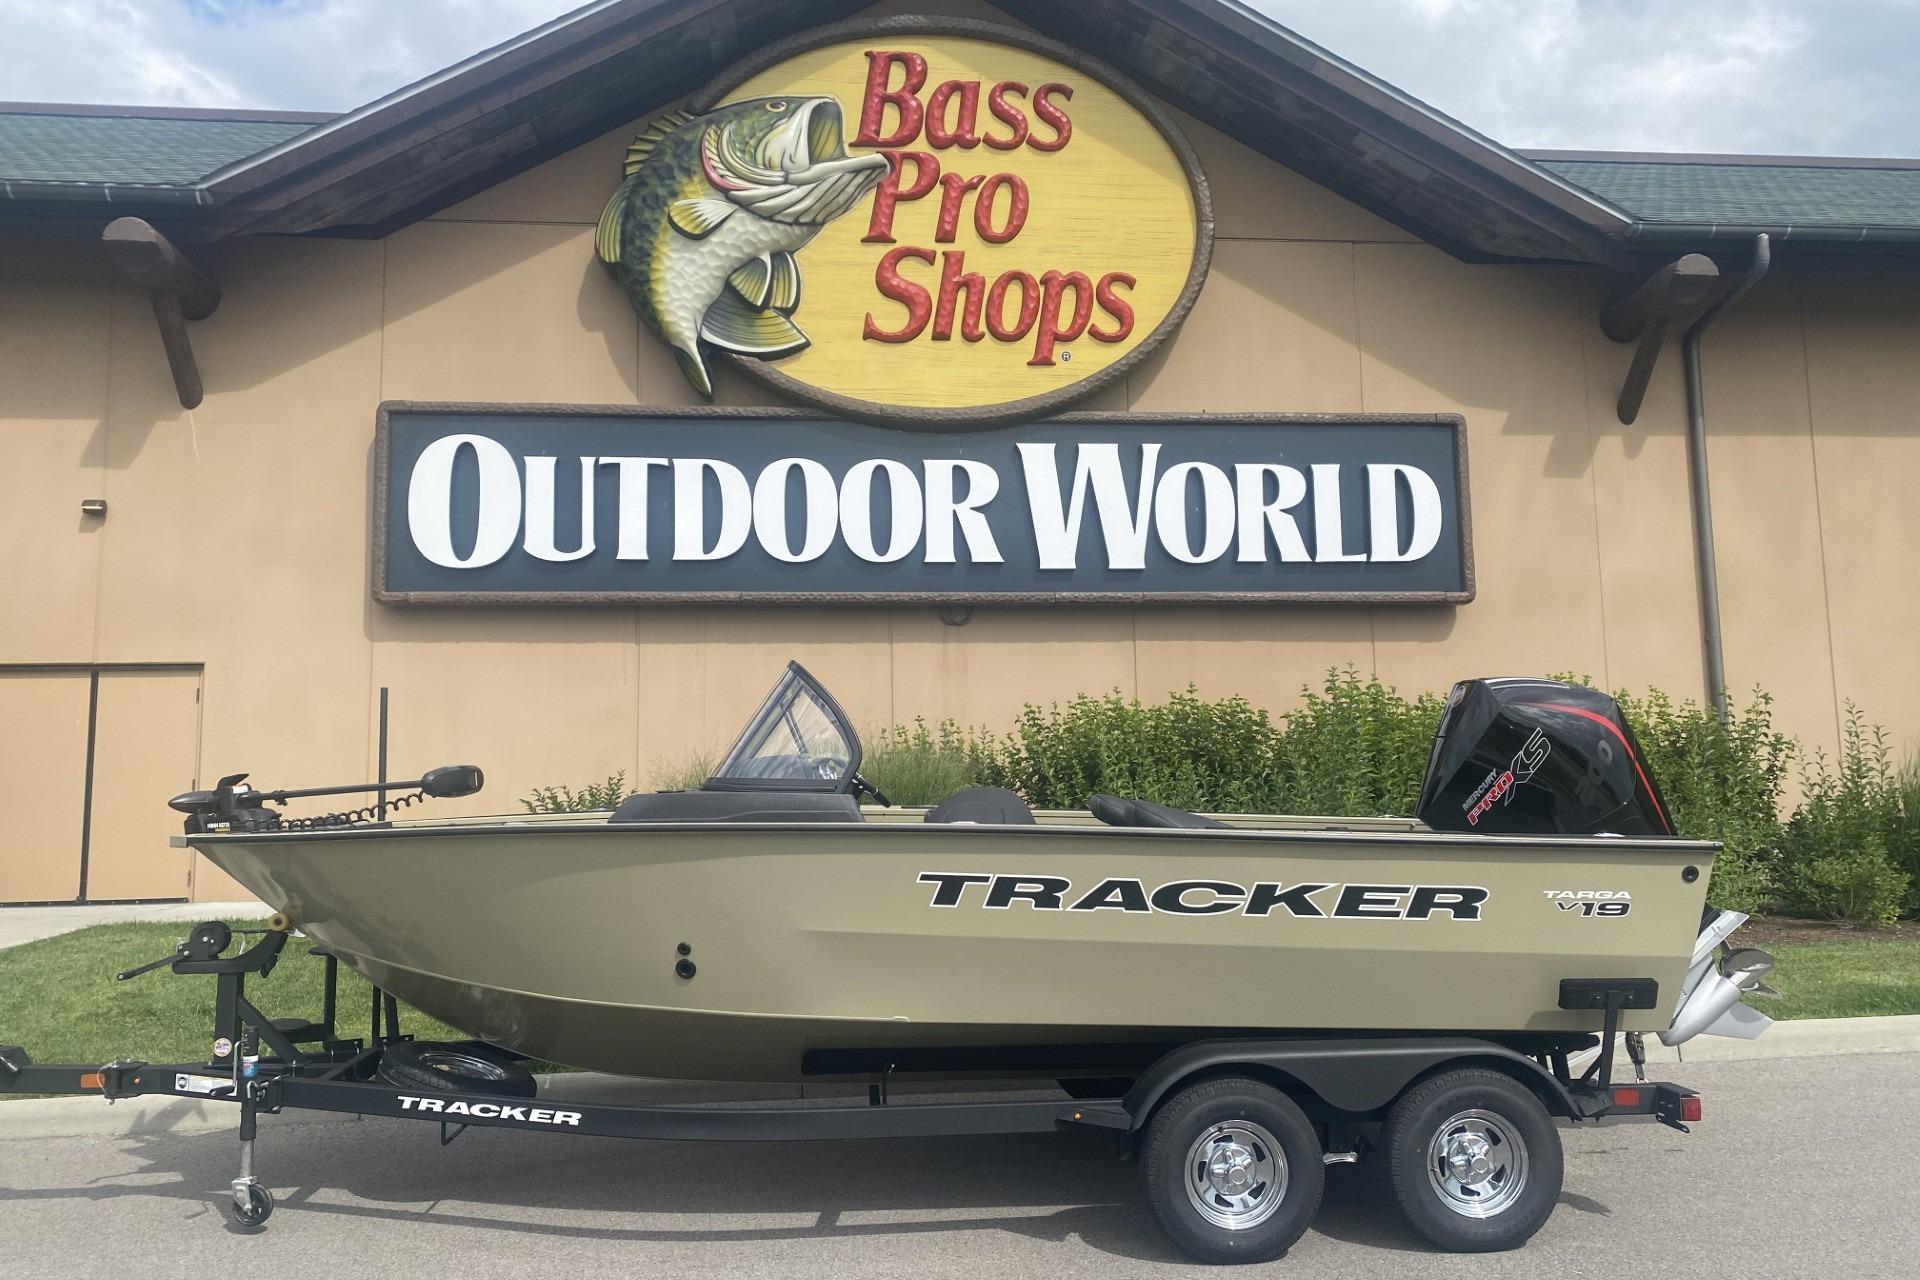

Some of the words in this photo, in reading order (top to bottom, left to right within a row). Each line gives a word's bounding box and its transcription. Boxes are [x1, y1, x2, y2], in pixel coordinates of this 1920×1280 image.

[848, 50, 1074, 151] Bass
[860, 150, 1029, 244] Pro
[862, 245, 1137, 366] Shops
[407, 433, 1005, 570] OUTDOOR
[1015, 442, 1444, 571] WORLD
[1462, 767, 1498, 811] MERCURY
[916, 871, 1490, 922] TRACKER
[1543, 890, 1632, 899] TARGA
[1555, 901, 1632, 918] V19
[397, 1096, 582, 1126] TRACKER
